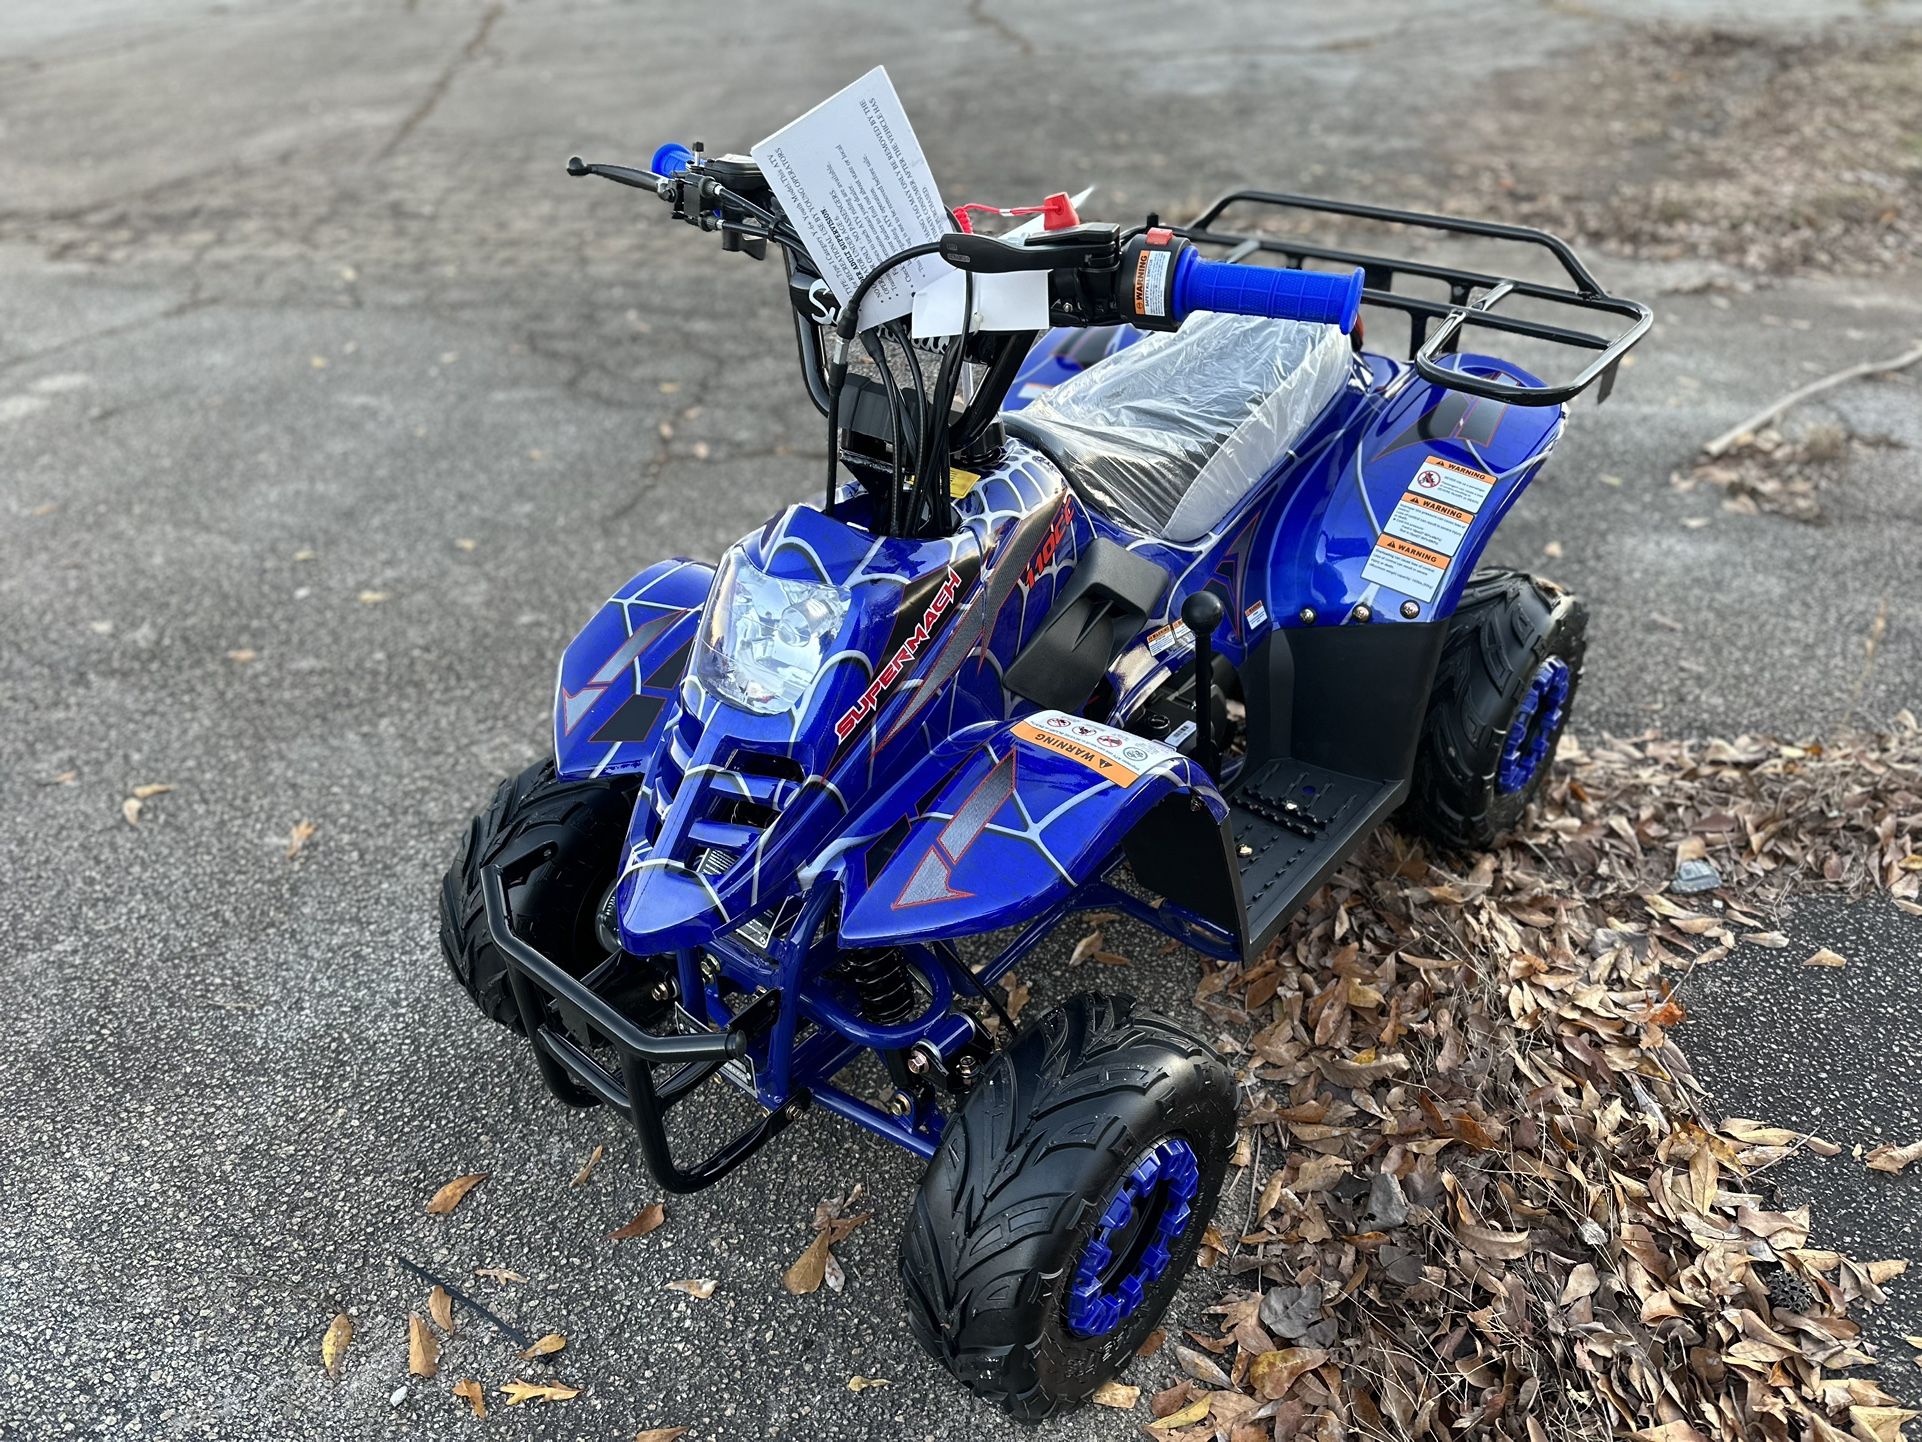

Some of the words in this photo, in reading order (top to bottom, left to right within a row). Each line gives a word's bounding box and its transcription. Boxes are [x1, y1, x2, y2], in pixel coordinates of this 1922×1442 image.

[858, 98, 871, 115] THE
[868, 96, 880, 114] HAS
[866, 113, 876, 126] BY
[875, 111, 895, 144] VEHICLE
[872, 124, 893, 160] REMOVED
[890, 141, 902, 158] THE
[835, 143, 847, 159] local
[766, 152, 779, 169] ATV
[774, 147, 801, 187] OPERATORS
[889, 159, 898, 170] BE
[897, 156, 912, 179] AFTER
[847, 165, 858, 179] state
[867, 167, 881, 186] before
[894, 168, 908, 190] ONLY
[839, 188, 848, 198] are
[854, 179, 866, 196] about
[796, 186, 815, 212] YOUNG
[863, 195, 871, 205] out
[876, 185, 893, 210] removed
[904, 189, 915, 205] MAY
[908, 178, 930, 215] CONSUMER
[794, 202, 809, 220] Youth
[843, 197, 857, 215] riding
[857, 201, 868, 215] your
[867, 205, 878, 218] find
[911, 203, 922, 219] TAG
[811, 212, 820, 222] BY
[852, 214, 864, 229] ATV
[864, 215, 878, 235] contact
[882, 214, 893, 228] ATV
[816, 221, 828, 235] USE
[835, 219, 848, 235] AGE
[851, 230, 861, 241] NO
[877, 223, 890, 241] dealer
[917, 218, 931, 238] HANG
[860, 229, 872, 244] teach
[814, 235, 834, 261] Category
[843, 234, 860, 257] UNDER
[858, 244, 873, 263] ONLY
[887, 240, 898, 253] your
[823, 234, 855, 281] RECREATIONAL
[843, 249, 859, 271] ADULT
[830, 263, 843, 278] Type
[899, 265, 912, 282] Check
[1136, 255, 1148, 301] WARNING
[873, 288, 882, 298] NO
[1447, 463, 1486, 479] WARNING
[1422, 500, 1463, 518] WARNING
[1025, 496, 1075, 588] 110CC
[1398, 543, 1437, 562] WARNING
[834, 565, 962, 745] SUPERMACH
[1034, 733, 1095, 762] WARNING
